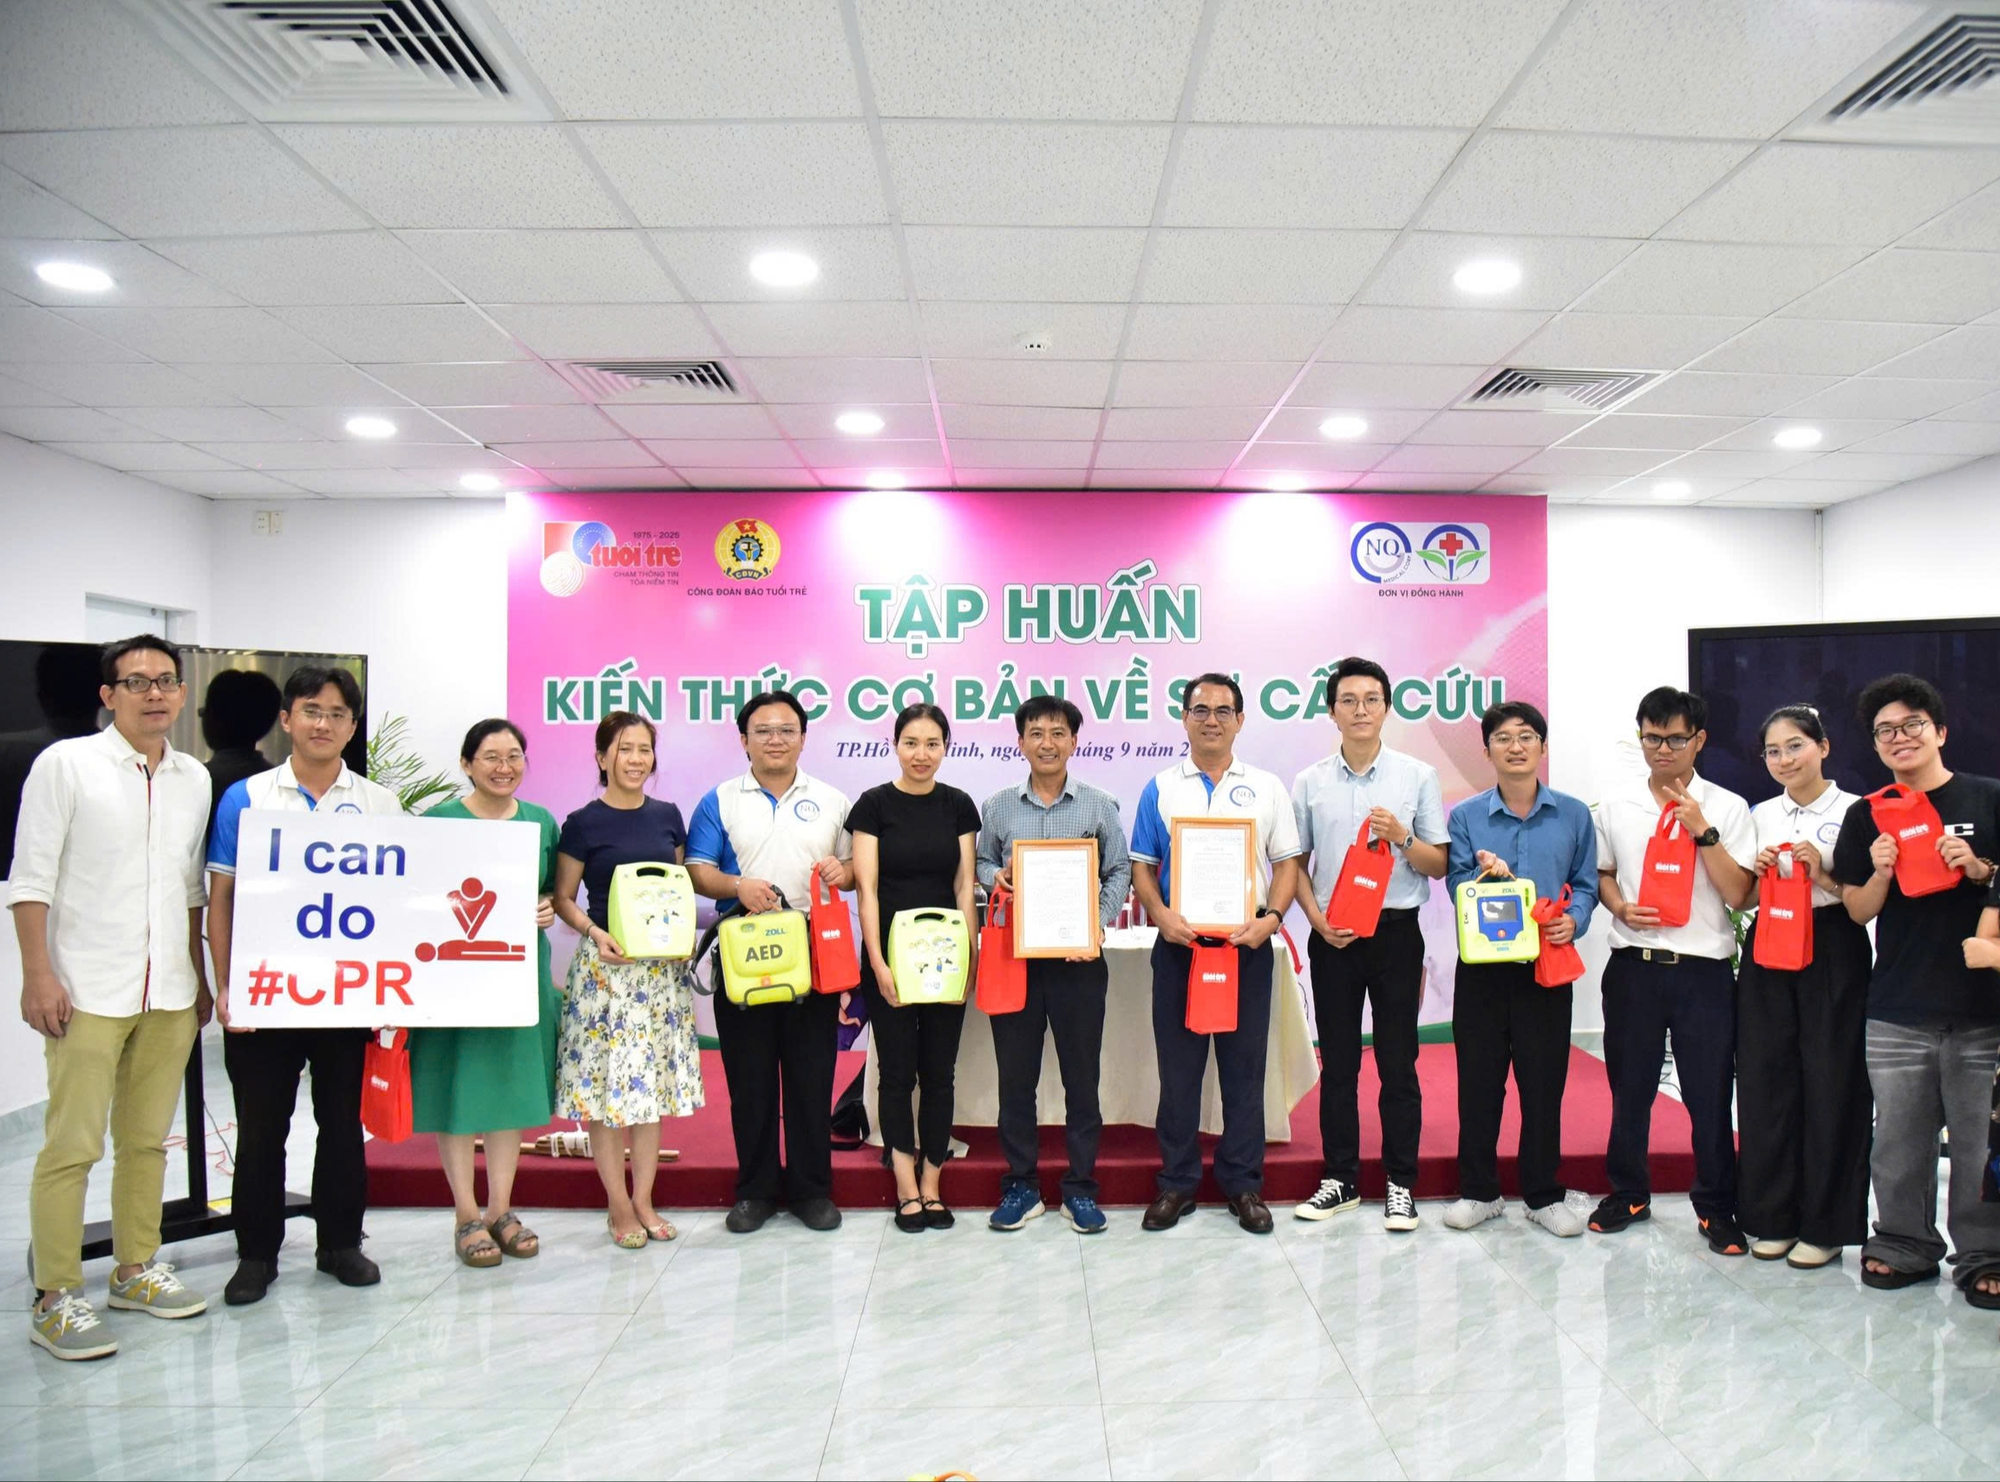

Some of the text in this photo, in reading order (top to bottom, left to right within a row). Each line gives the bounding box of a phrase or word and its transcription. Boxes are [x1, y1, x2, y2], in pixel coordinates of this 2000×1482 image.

[633, 531, 651, 539] 1975
[659, 531, 680, 539] 2025
[1365, 538, 1401, 559] NQ
[687, 584, 807, 596] CÔNG ĐOÀN BÁO TUỔI TRẺ
[1378, 586, 1464, 599] ĐƠN VỊ ĐỒNG HÀNH
[858, 563, 1197, 656] TẬP HUẤN
[546, 660, 663, 721] KIẾN
[847, 672, 935, 721] CƠ
[1084, 656, 1149, 720] VỀ
[1259, 660, 1342, 721] CẤ
[1392, 665, 1503, 721] CỨU
[836, 738, 890, 758] TP.Hồ
[1071, 741, 1115, 762] áng
[1121, 741, 1131, 757] 9
[1136, 742, 1174, 757] năm
[268, 828, 406, 877] I can
[296, 892, 376, 940] do
[765, 928, 786, 937] ZOLL
[745, 943, 783, 963] AED
[248, 958, 415, 1006] #CPR
